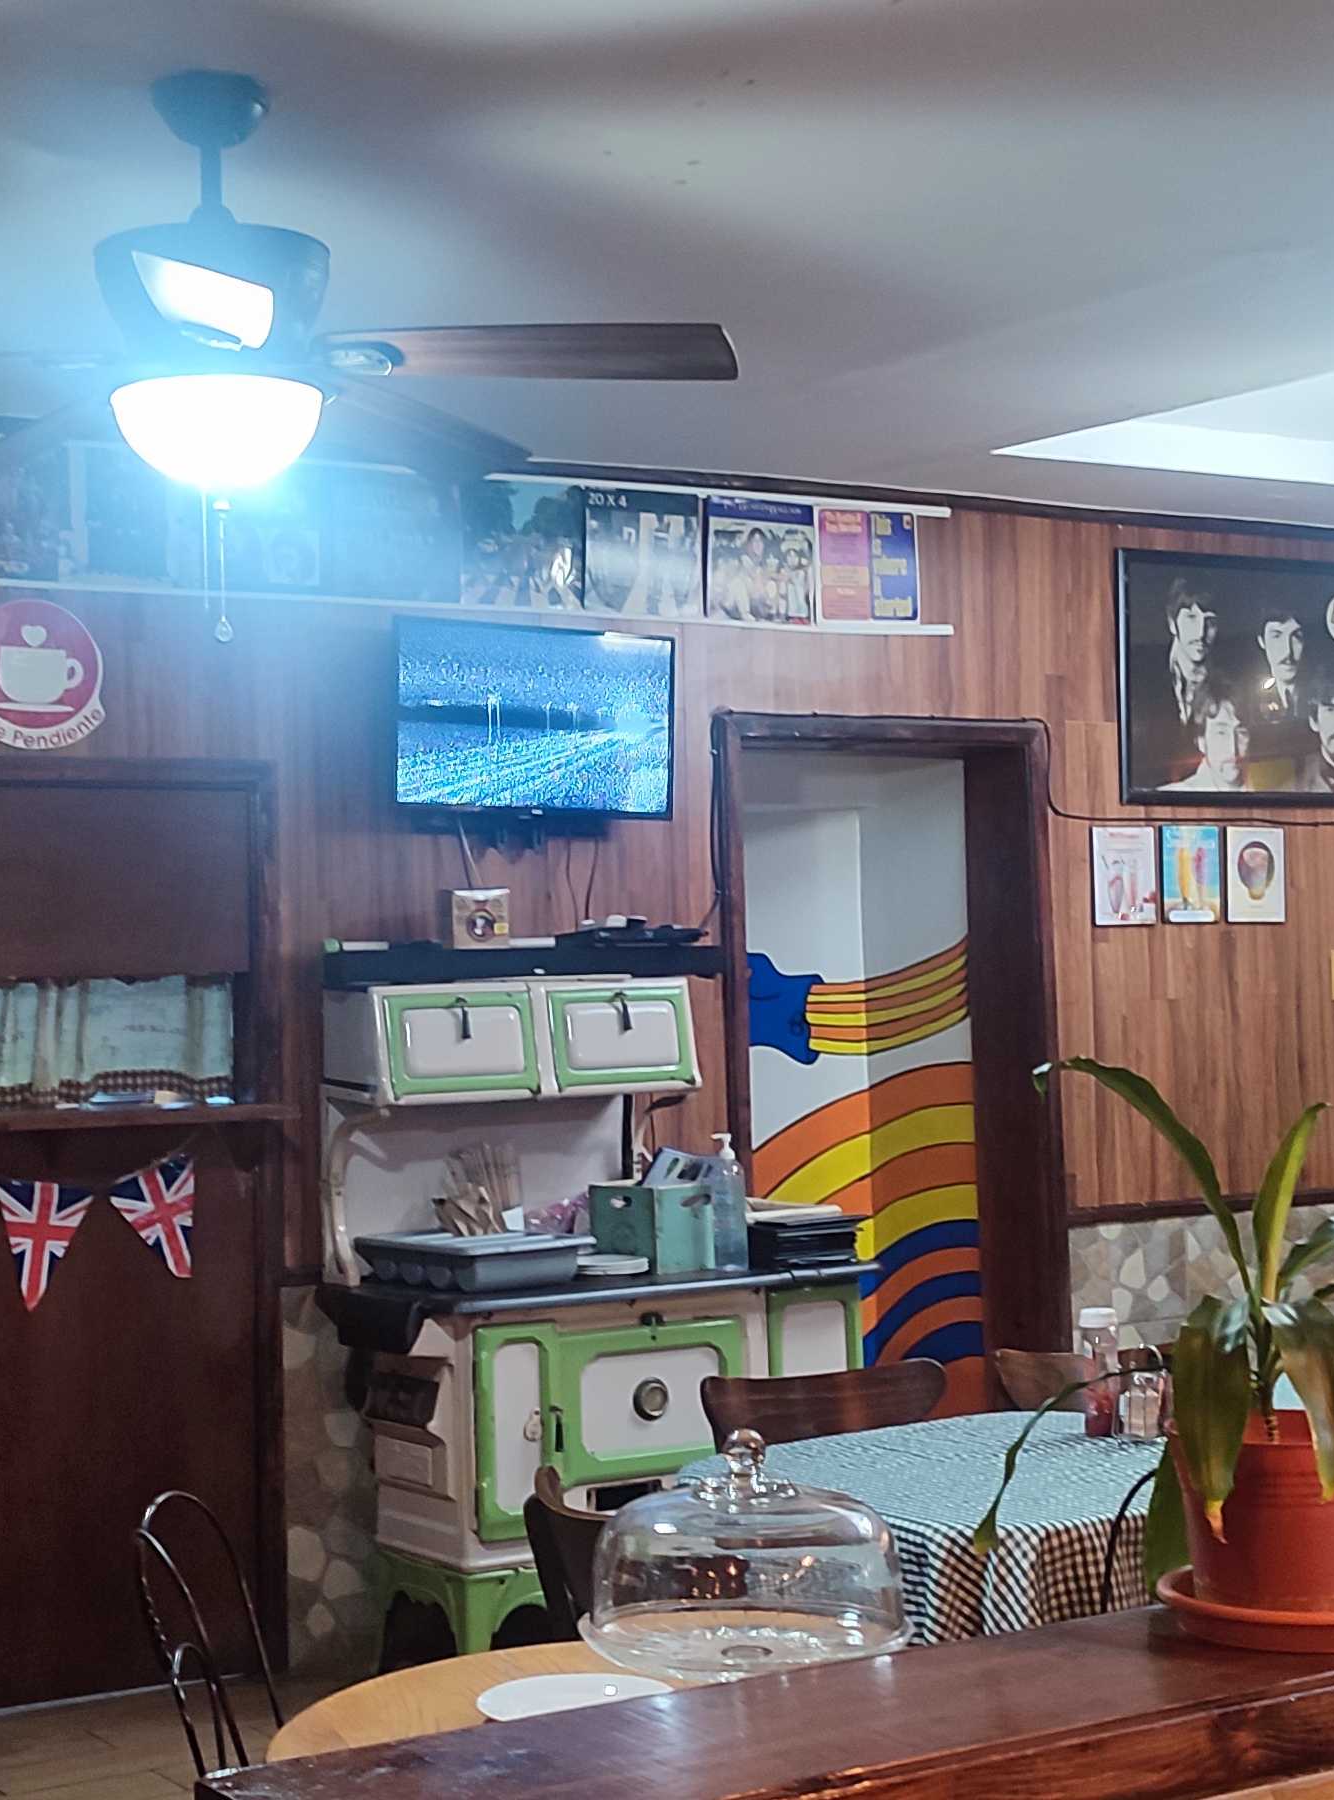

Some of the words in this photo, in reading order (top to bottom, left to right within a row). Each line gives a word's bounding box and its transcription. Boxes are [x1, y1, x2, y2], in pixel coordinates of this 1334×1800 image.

[588, 492, 605, 506] 20
[618, 494, 627, 508] 4
[12, 708, 103, 748] Pendiente
